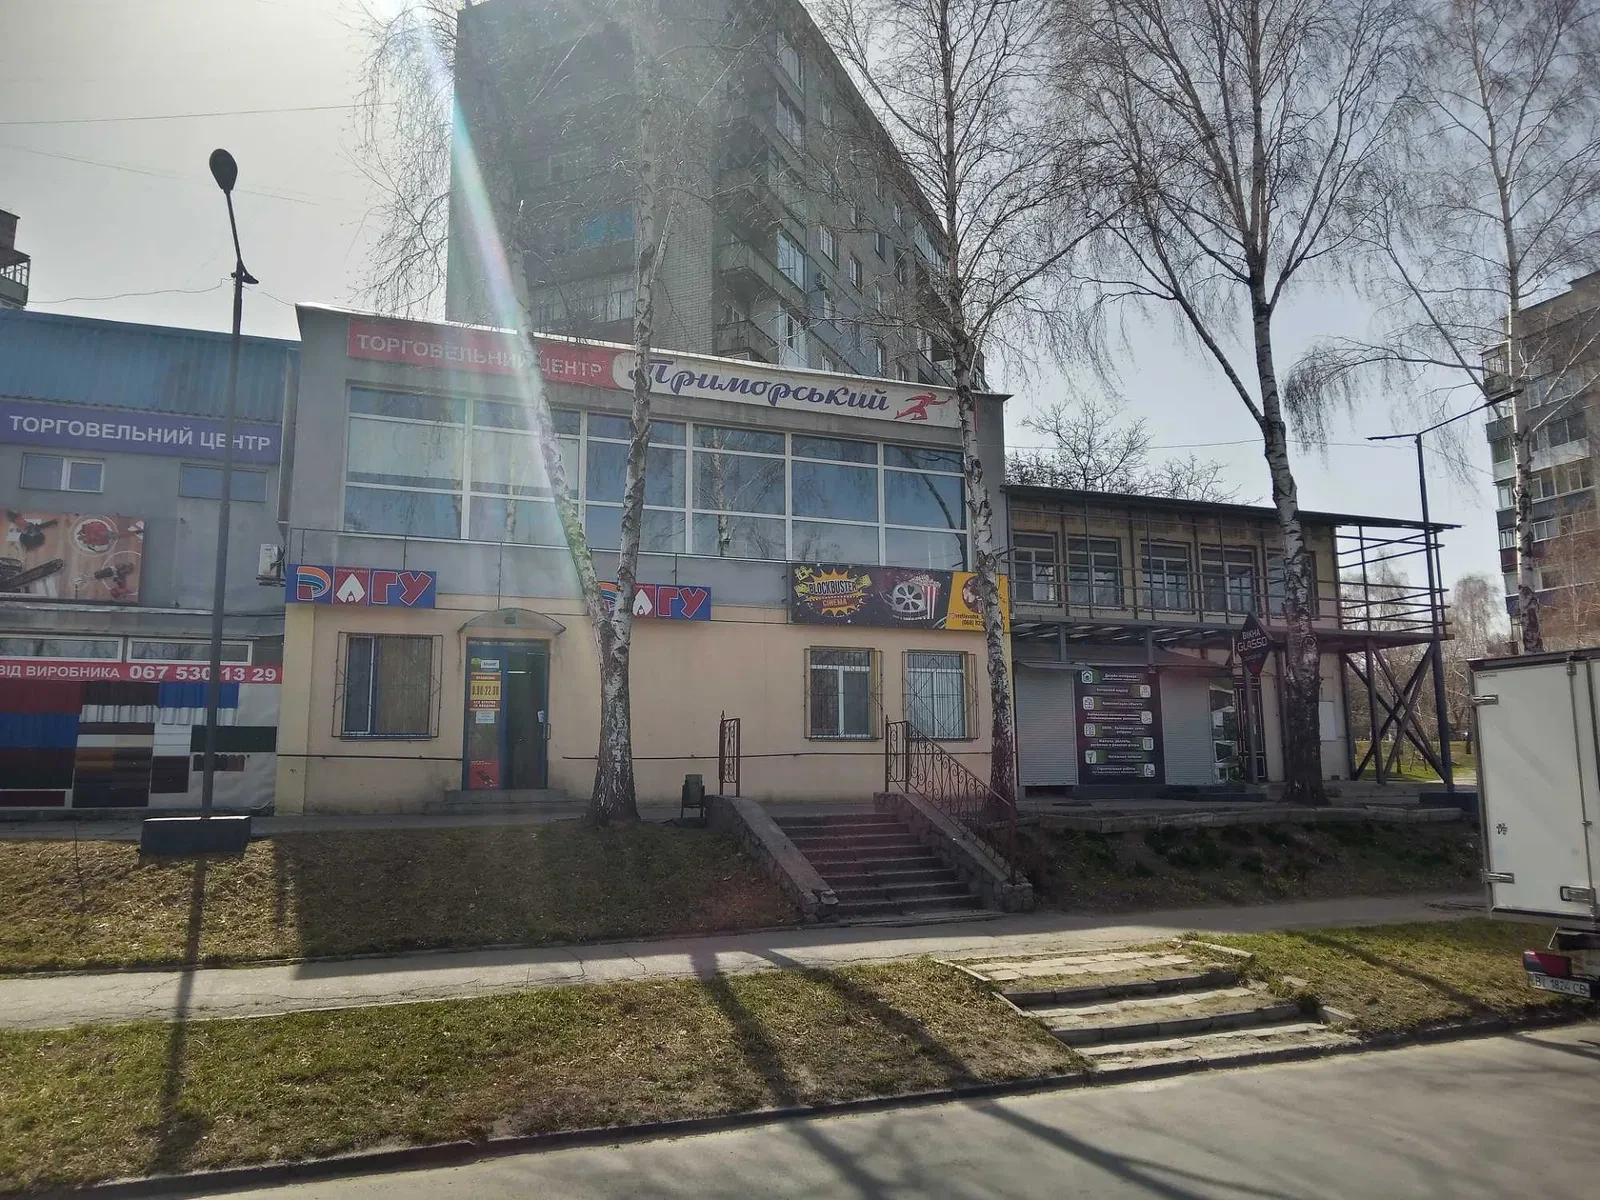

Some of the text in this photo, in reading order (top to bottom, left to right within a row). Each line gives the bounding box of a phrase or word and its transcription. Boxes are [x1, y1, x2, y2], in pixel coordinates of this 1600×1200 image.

[628, 359, 890, 411] Приморський
[9, 415, 271, 451] ТОРГОВЕЛЬНИЙ ЦЕНТР
[808, 580, 857, 595] BLOCKBUSTER
[822, 597, 848, 607] CINEMA
[1242, 628, 1261, 640] ВІКНА
[1238, 636, 1268, 651] GLASSO
[0, 665, 277, 682] ВІД ВИРОБНИКА 067 530 13 29
